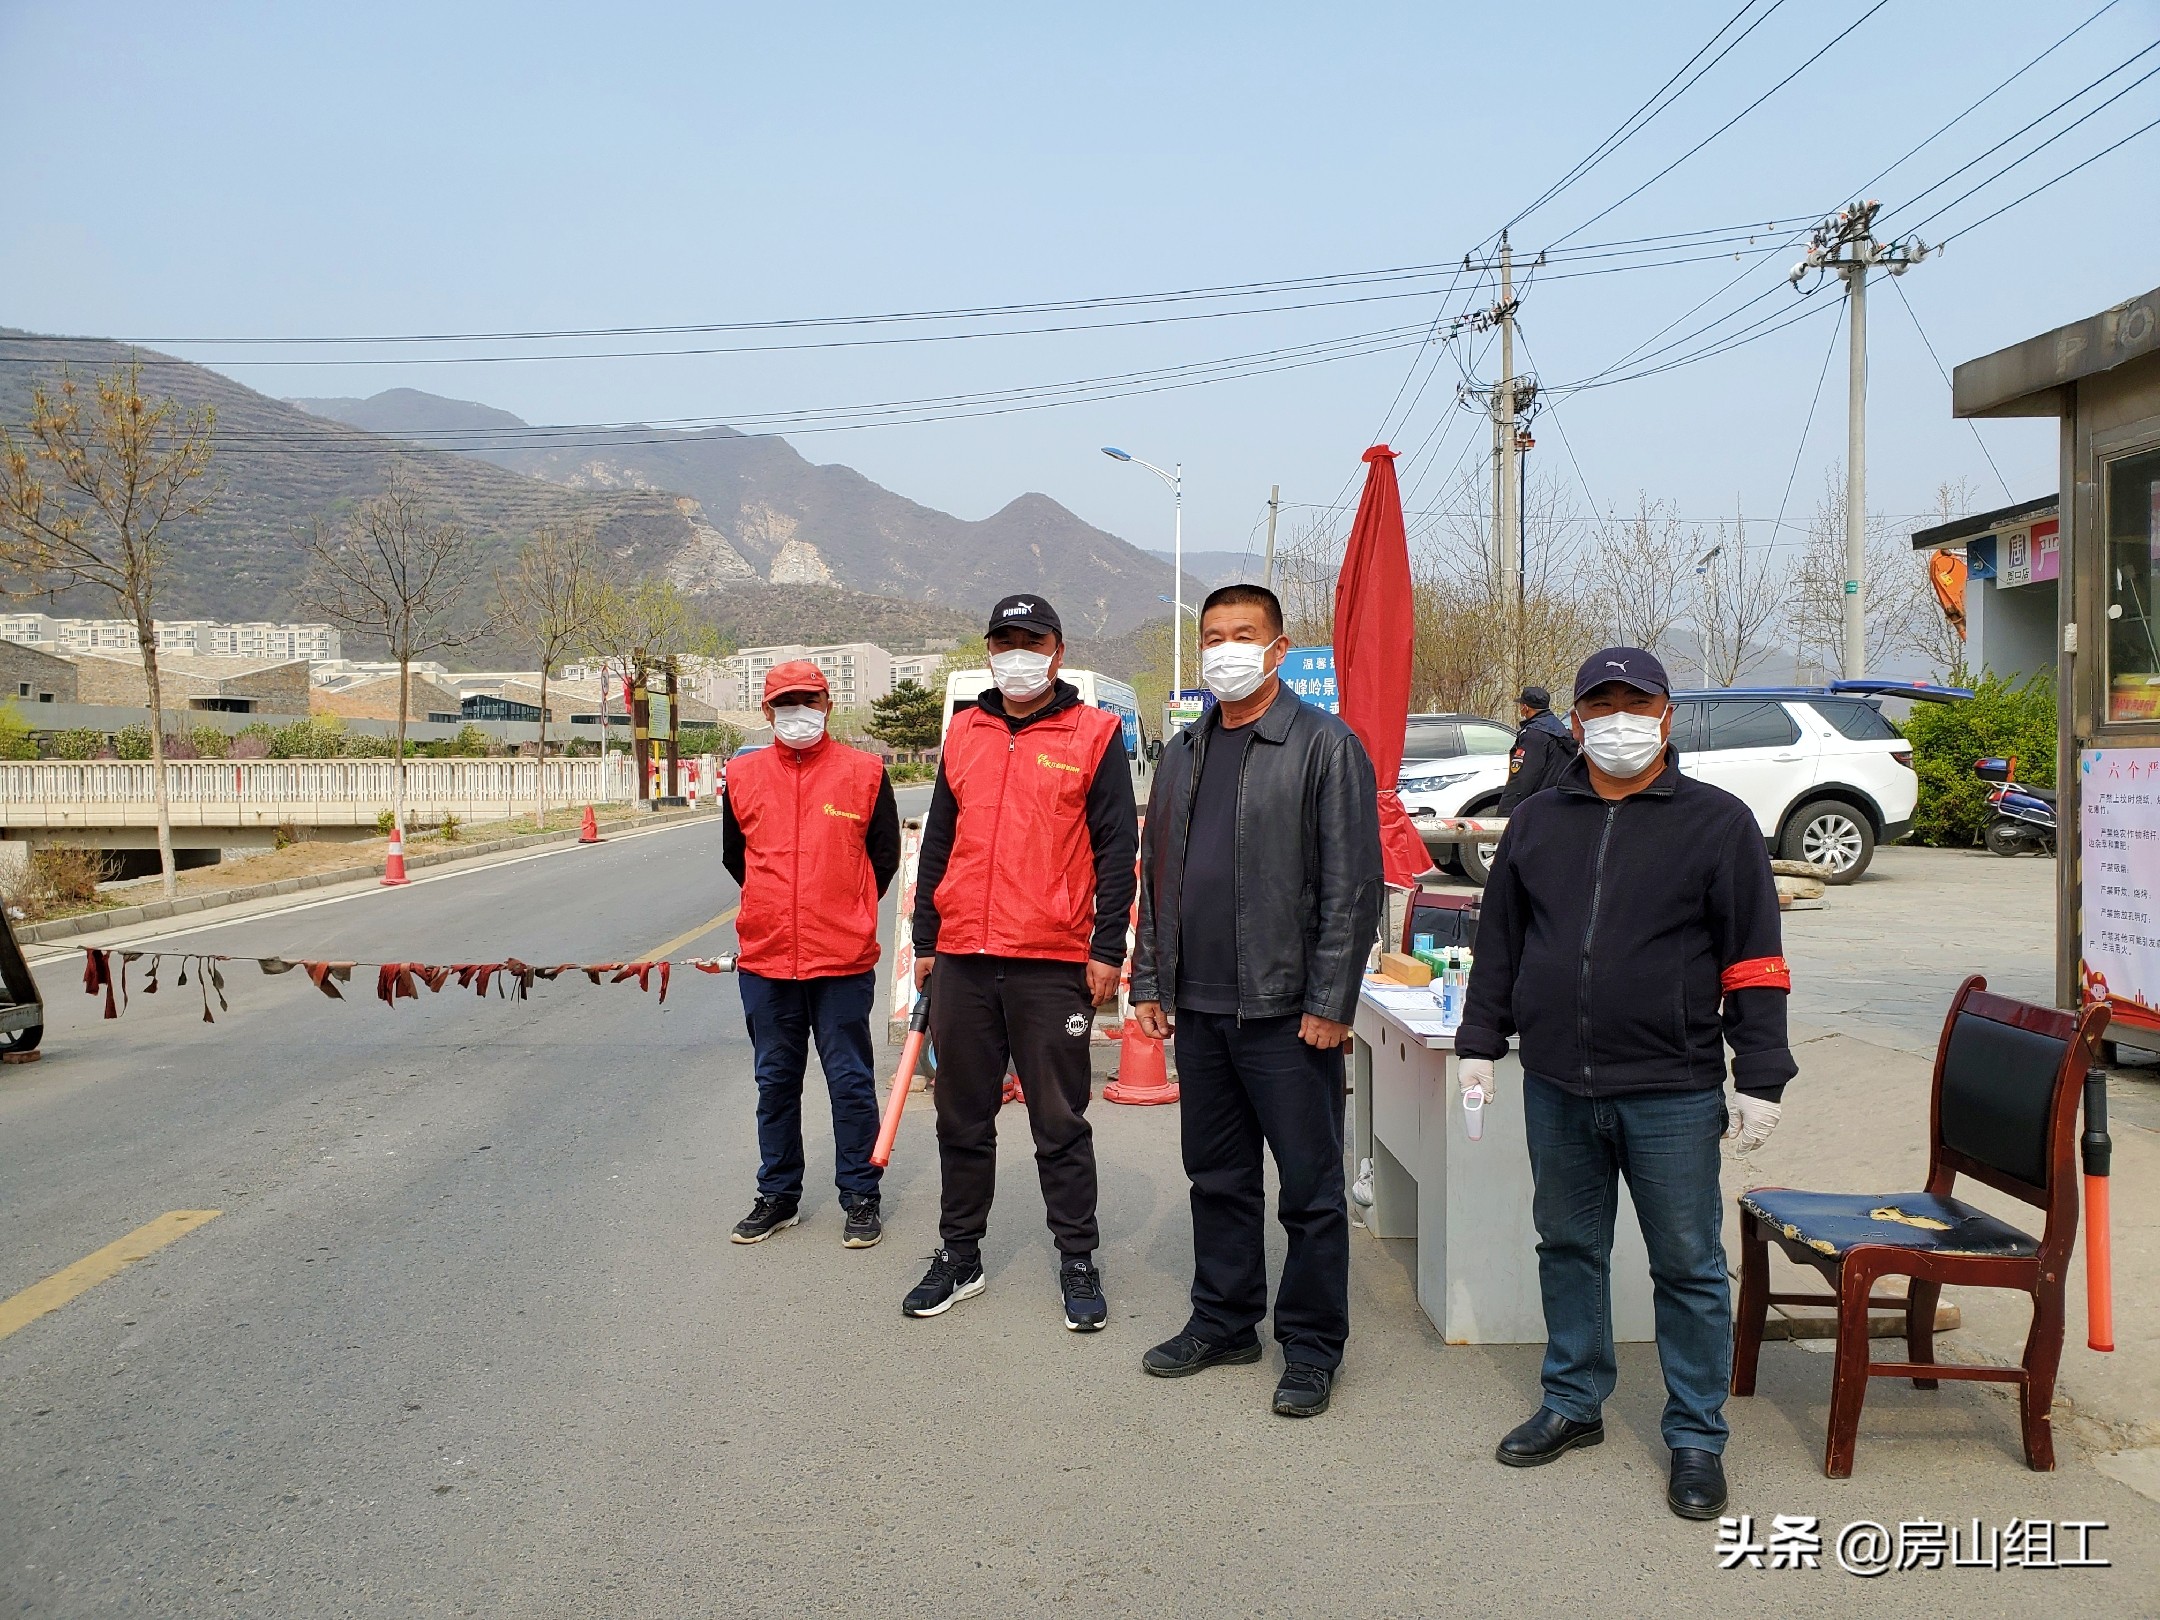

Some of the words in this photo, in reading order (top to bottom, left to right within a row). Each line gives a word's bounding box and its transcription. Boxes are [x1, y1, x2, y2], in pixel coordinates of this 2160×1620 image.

[2006, 567, 2030, 582] 周口店
[1002, 607, 1028, 618] PUMA
